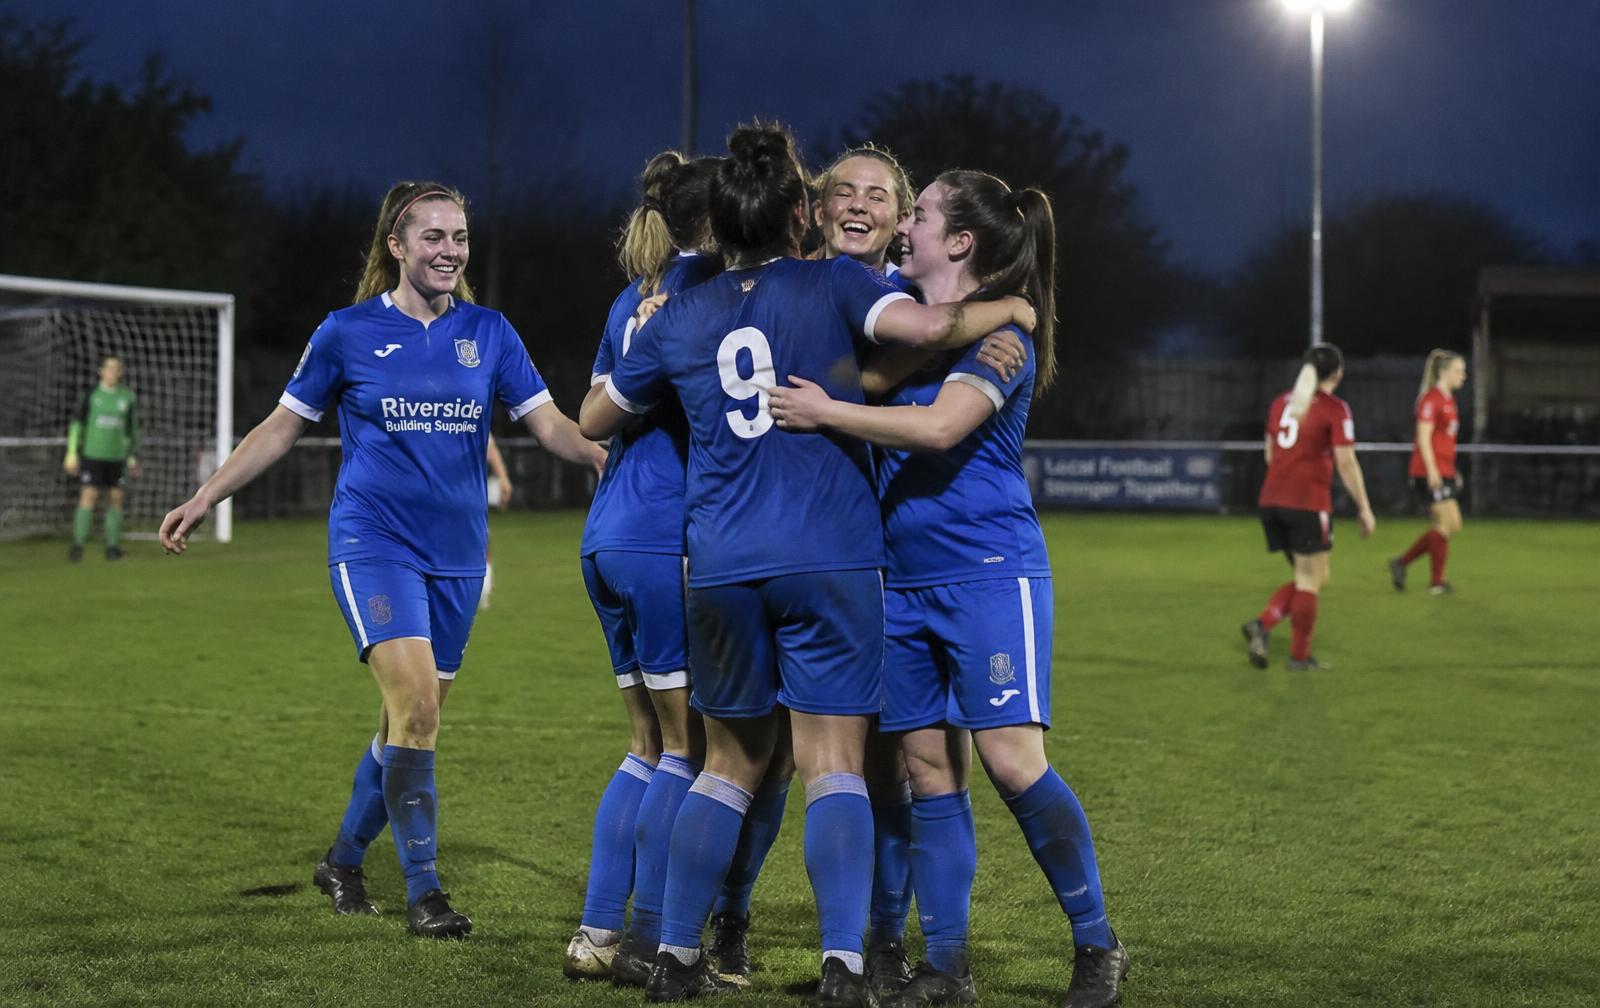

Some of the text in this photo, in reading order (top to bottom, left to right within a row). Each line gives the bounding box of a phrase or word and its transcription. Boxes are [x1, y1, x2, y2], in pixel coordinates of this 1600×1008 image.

[717, 326, 776, 438] 9
[380, 397, 483, 419] Riverside
[385, 419, 432, 434] Building
[1277, 401, 1299, 449] 5
[1099, 456, 1173, 477] Football
